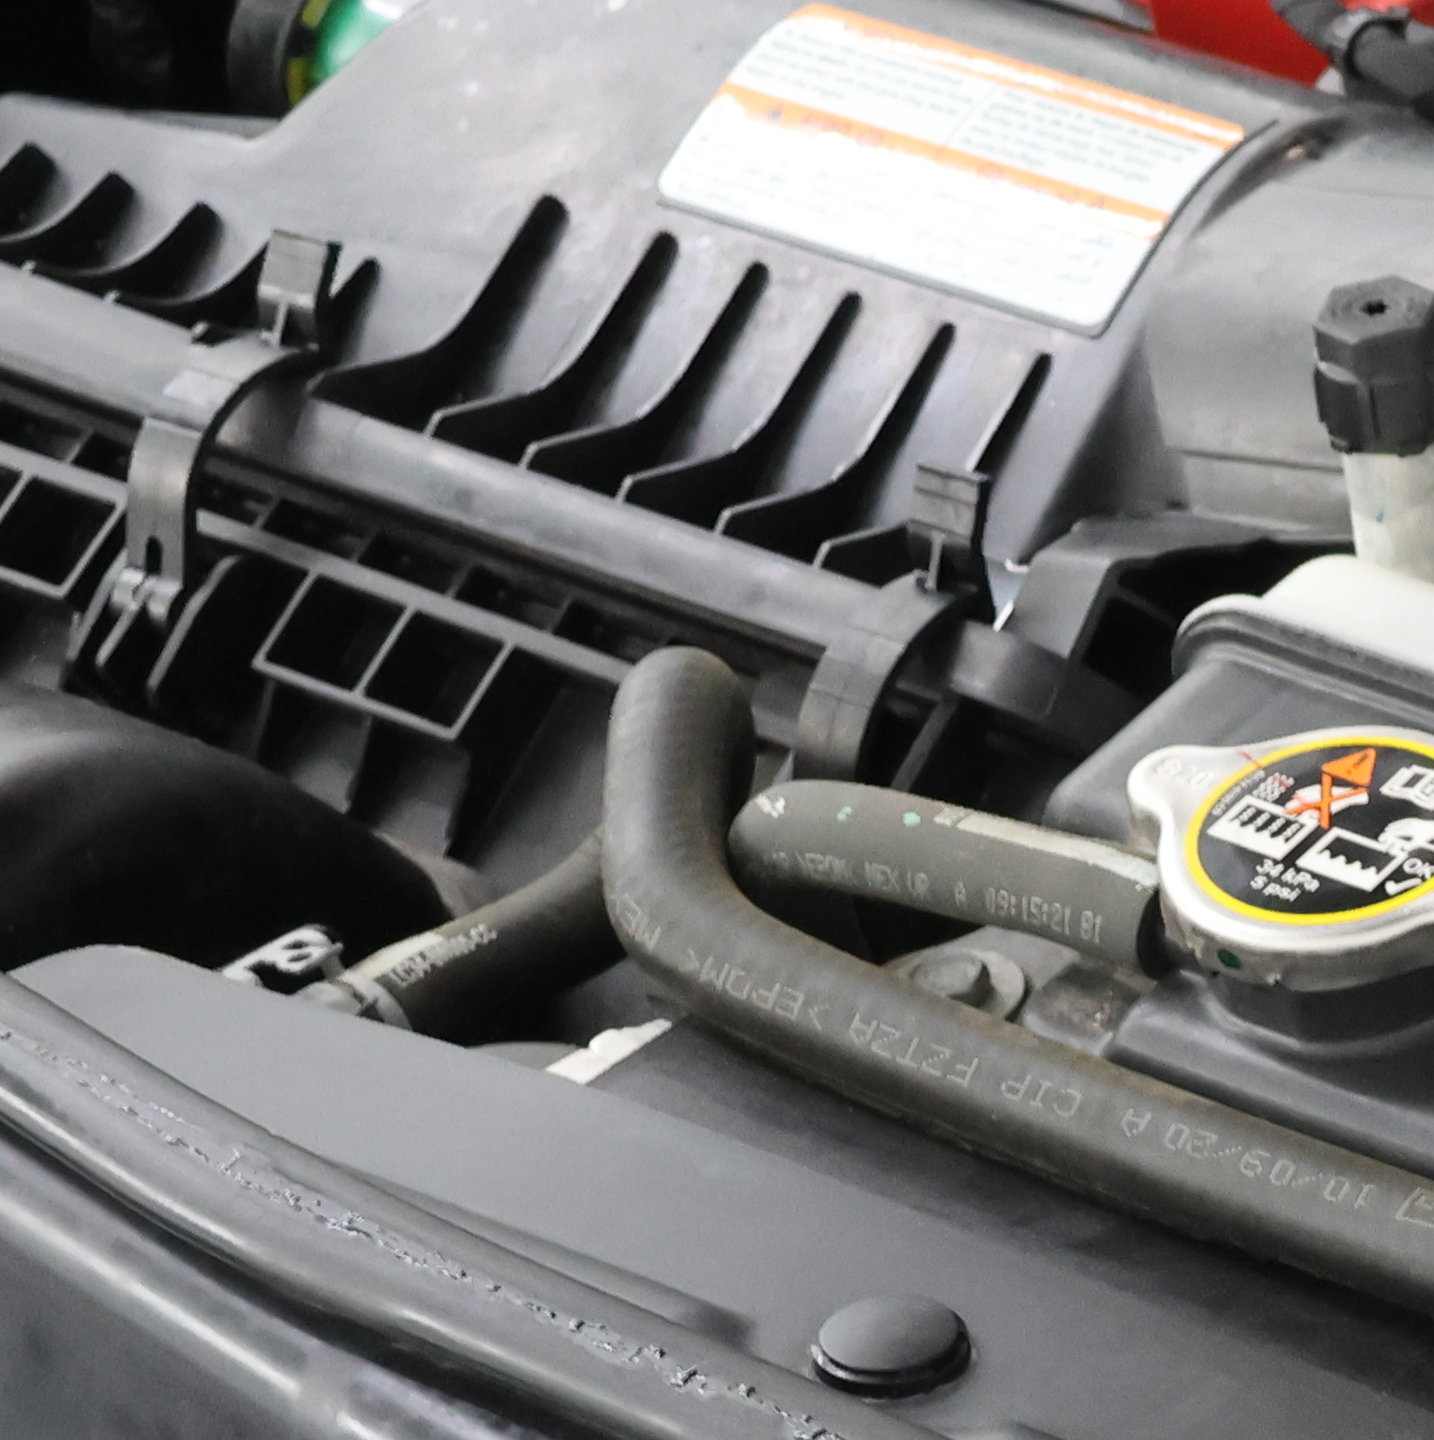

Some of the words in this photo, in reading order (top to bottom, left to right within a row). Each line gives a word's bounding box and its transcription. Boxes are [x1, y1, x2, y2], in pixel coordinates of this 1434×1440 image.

[1249, 875, 1264, 891] 5
[1262, 881, 1303, 903] psi
[1256, 858, 1283, 879] 34
[1281, 864, 1321, 893] kPa
